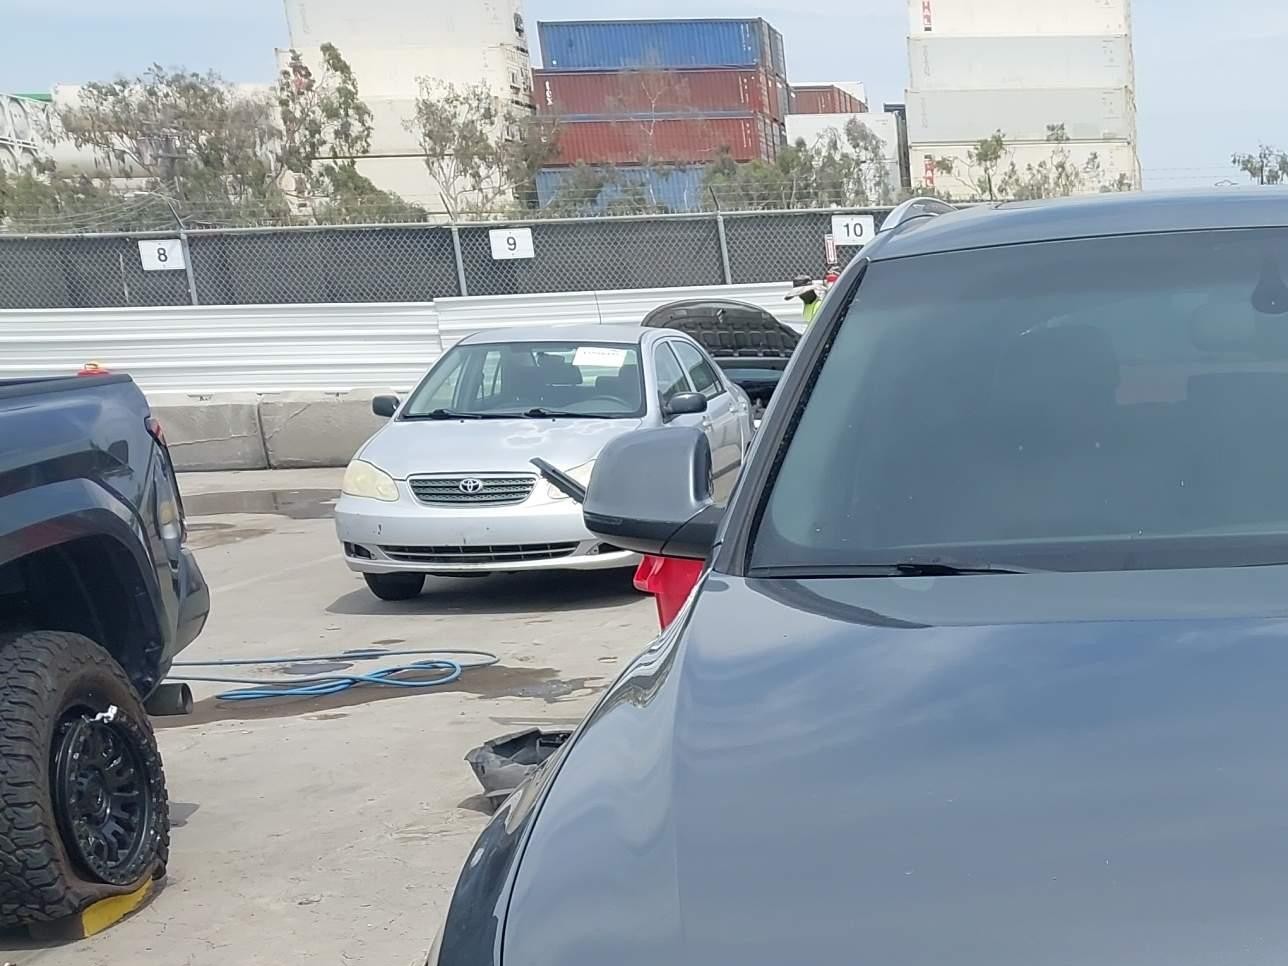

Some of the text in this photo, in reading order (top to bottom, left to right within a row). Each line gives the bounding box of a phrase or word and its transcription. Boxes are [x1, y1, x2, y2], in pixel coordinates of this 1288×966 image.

[843, 222, 863, 237] 10
[506, 236, 517, 251] 9
[157, 247, 168, 262] 8
